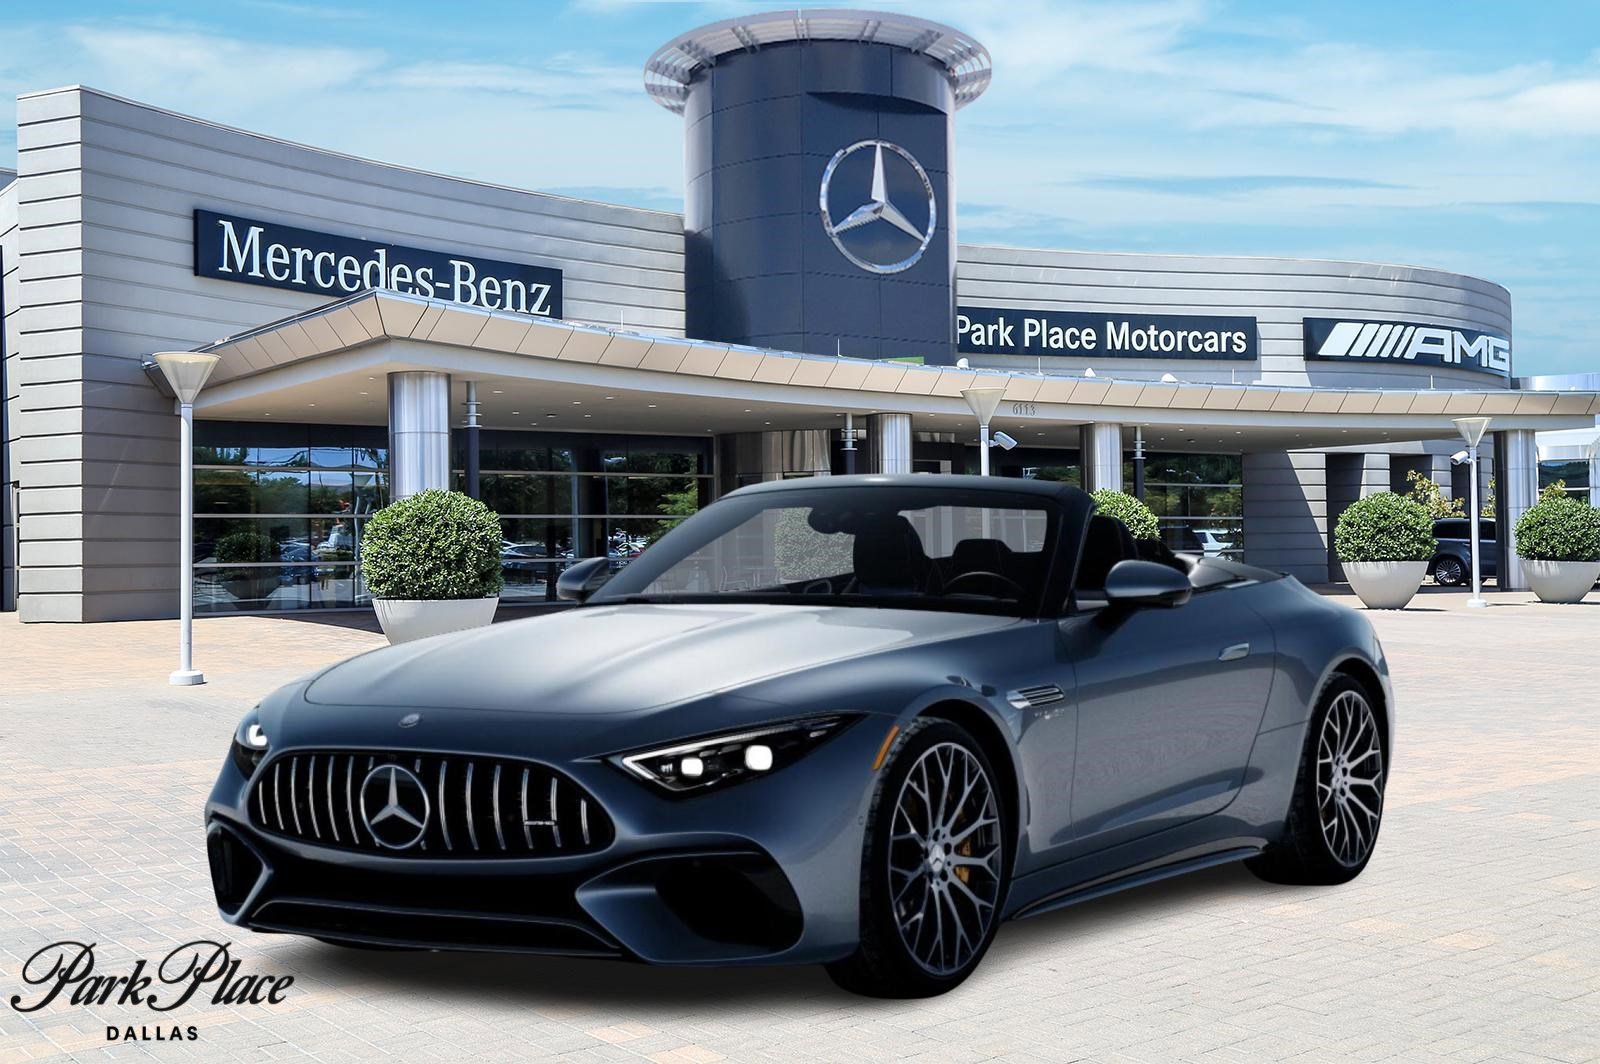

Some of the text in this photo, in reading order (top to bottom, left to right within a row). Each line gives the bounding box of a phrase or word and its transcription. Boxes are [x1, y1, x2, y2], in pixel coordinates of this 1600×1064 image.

[217, 219, 552, 316] Mercedes-Benz
[957, 314, 1248, 353] Park Place Motorcars
[1012, 402, 1036, 417] 6113
